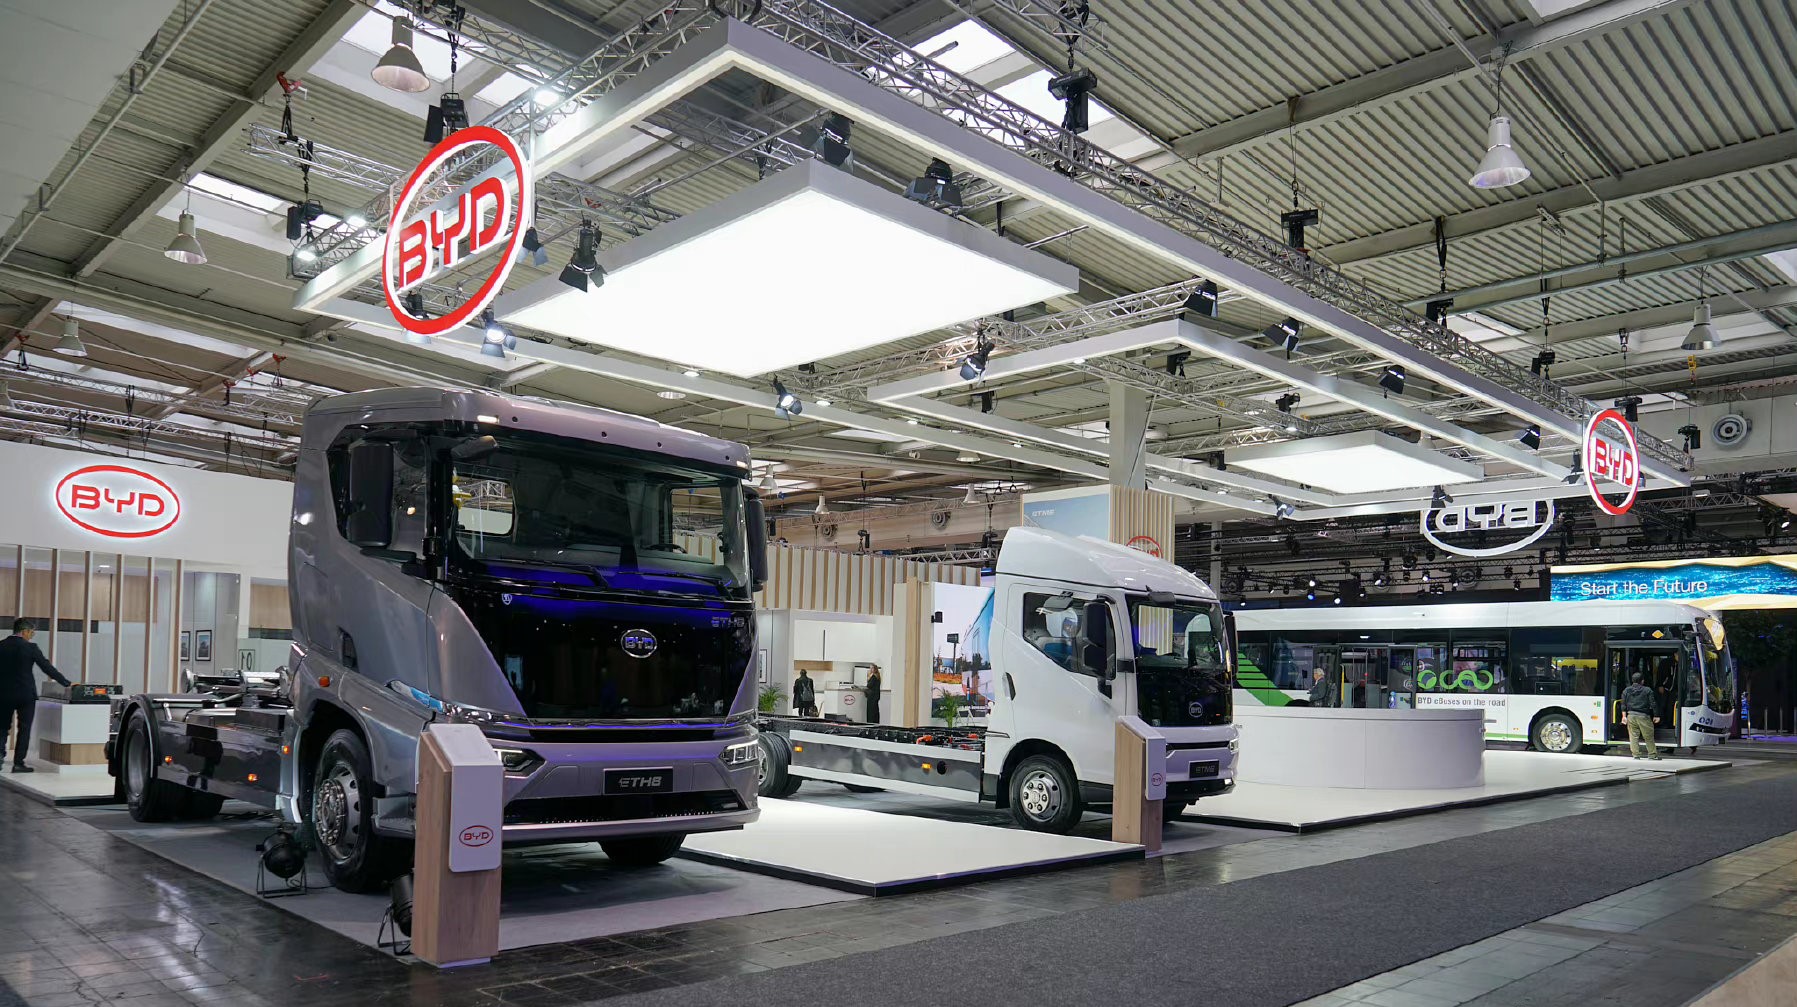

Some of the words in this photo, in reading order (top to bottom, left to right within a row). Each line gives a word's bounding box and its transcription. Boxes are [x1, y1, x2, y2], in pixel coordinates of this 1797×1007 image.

[399, 177, 510, 290] BYD
[1592, 437, 1634, 487] BYD
[71, 484, 165, 517] BYD
[1581, 582, 1618, 597] Start
[1623, 581, 1648, 595] the
[1653, 579, 1708, 595] Future
[625, 636, 654, 650] BYD
[1417, 697, 1432, 705] BYD
[1434, 698, 1460, 706] eBuses
[1473, 698, 1486, 706] the
[1488, 699, 1506, 707] road
[619, 776, 662, 788] ETH8
[464, 832, 490, 841] BYD
